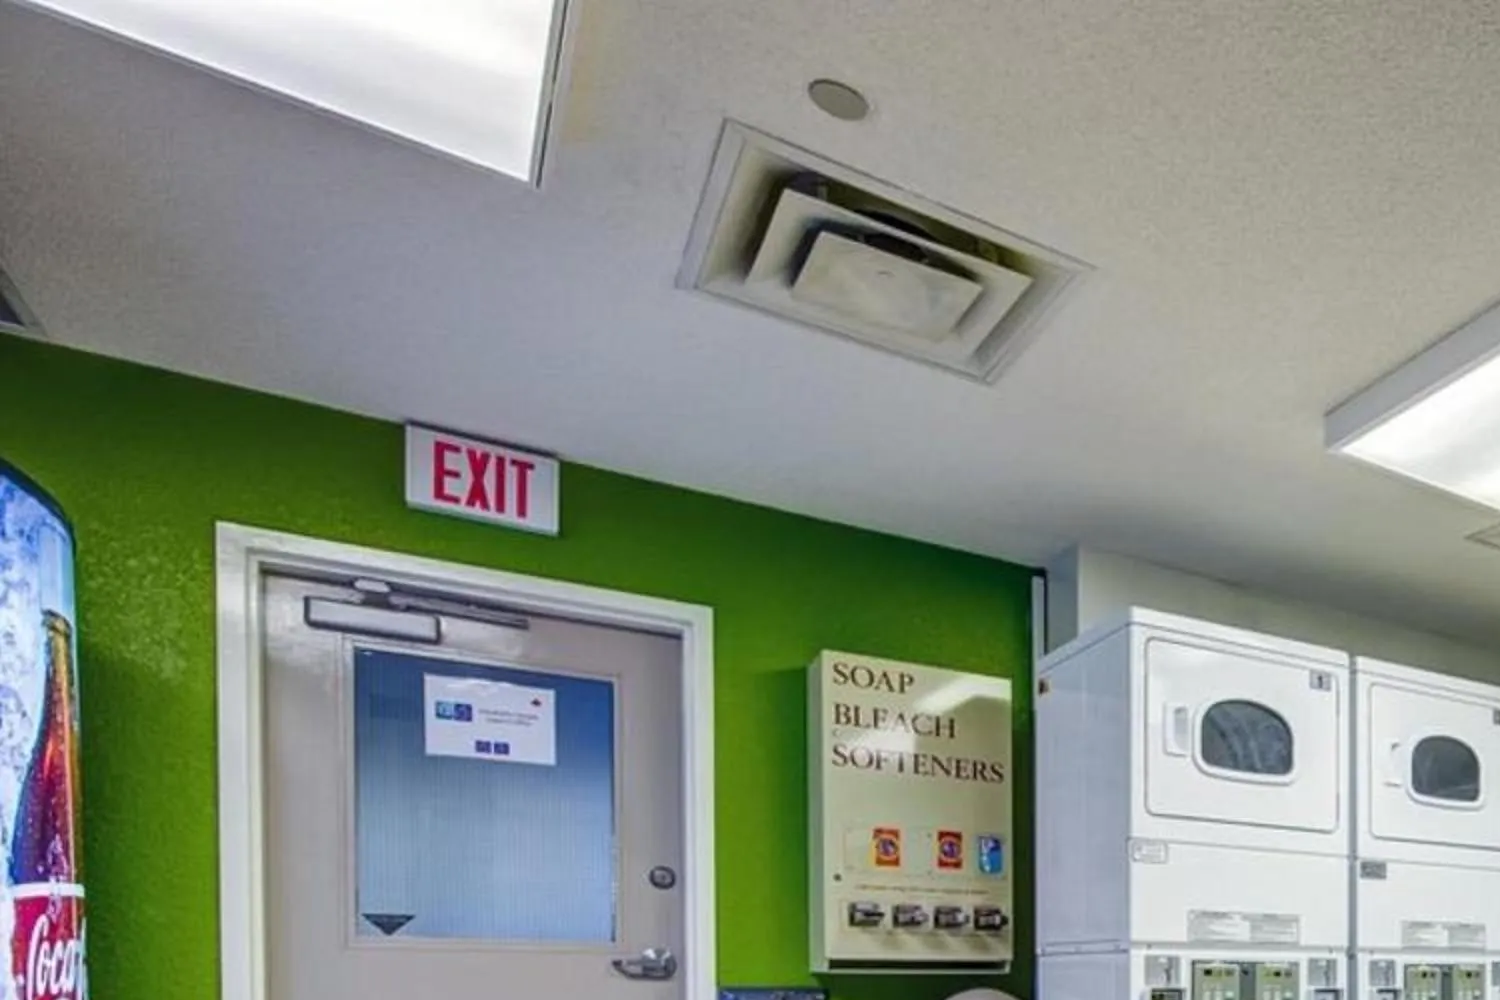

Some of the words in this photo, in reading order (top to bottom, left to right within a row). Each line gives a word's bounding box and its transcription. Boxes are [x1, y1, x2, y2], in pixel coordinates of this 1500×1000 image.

[433, 440, 536, 519] EXIT
[832, 661, 915, 694] SOAP
[834, 702, 956, 739] BLEACH
[831, 743, 1005, 784] SOFTENERS
